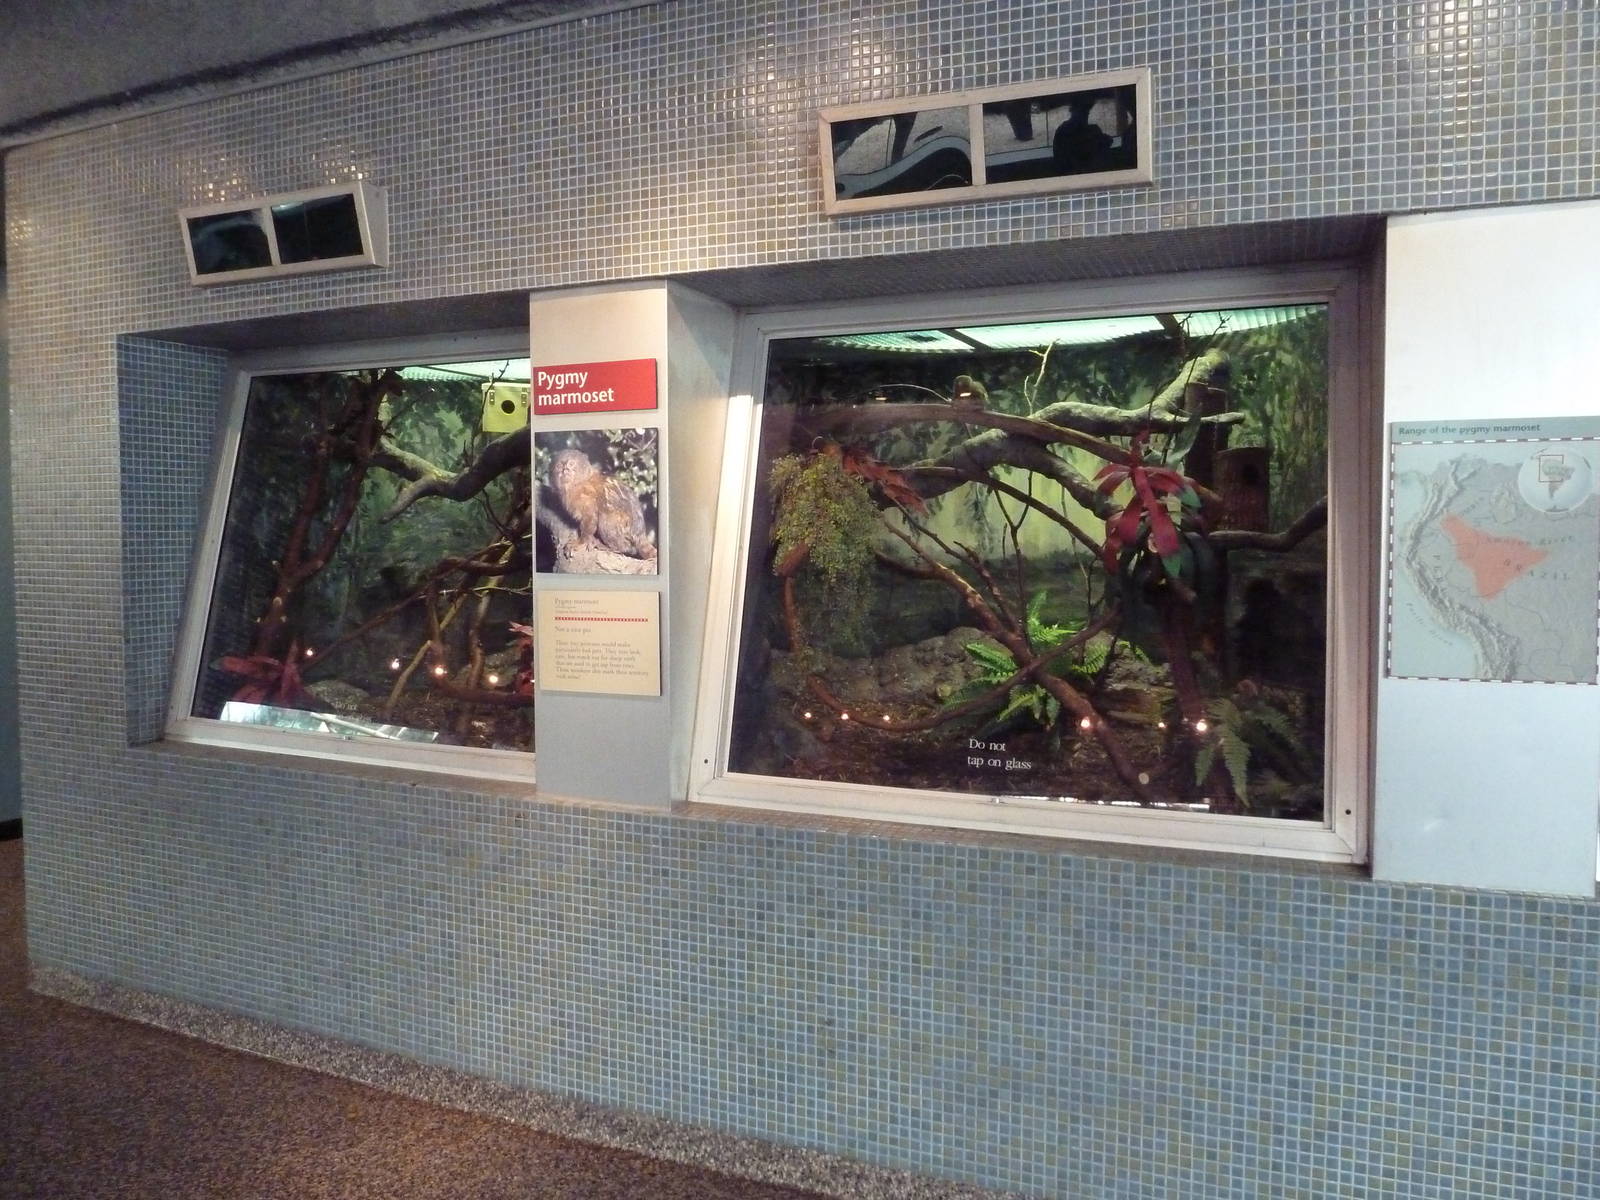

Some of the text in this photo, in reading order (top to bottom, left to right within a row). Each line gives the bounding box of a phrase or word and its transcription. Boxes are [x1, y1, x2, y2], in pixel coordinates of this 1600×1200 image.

[537, 371, 588, 390] Pygmy
[538, 387, 615, 406] marmoset
[1399, 424, 1540, 436] Range of the pygmy marmoset
[969, 738, 1006, 751] Do not
[967, 756, 1032, 770] tap on glass
